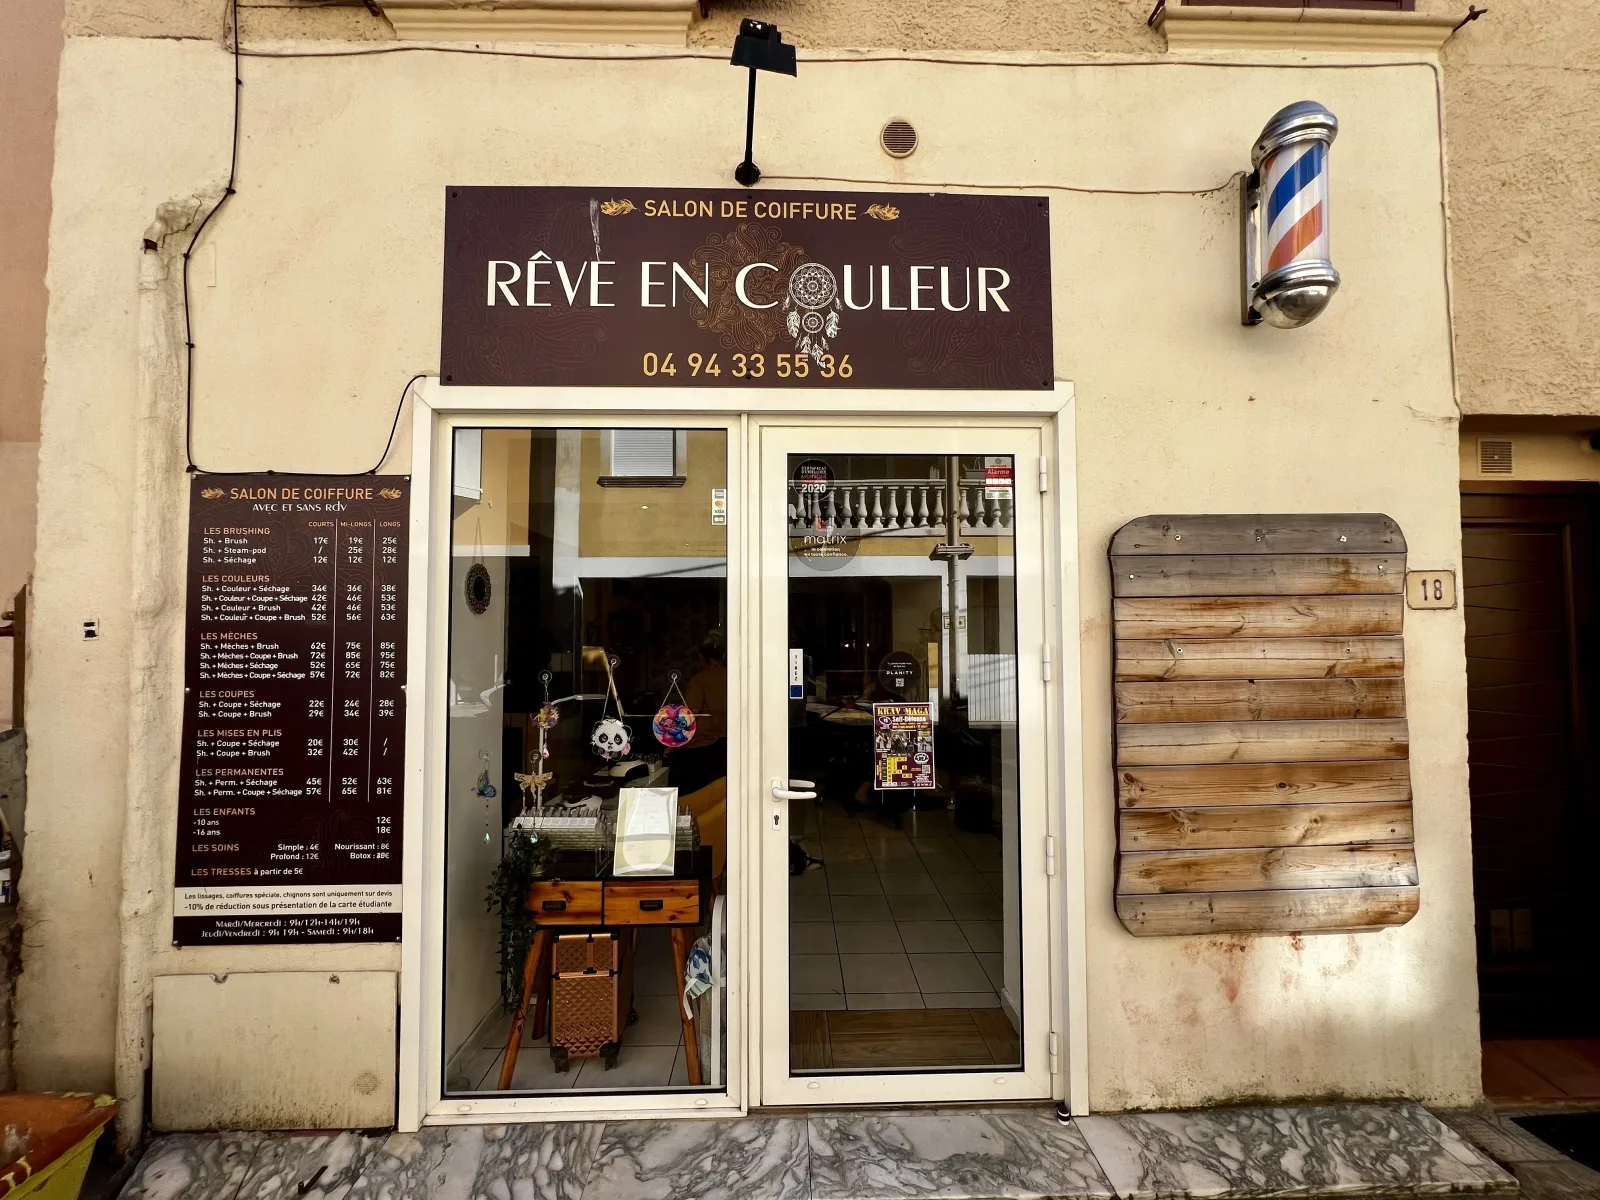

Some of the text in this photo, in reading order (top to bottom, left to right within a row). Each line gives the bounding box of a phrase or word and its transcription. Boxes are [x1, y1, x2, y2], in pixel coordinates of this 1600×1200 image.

[644, 199, 857, 221] SALON DE COIFFURE
[487, 250, 616, 307] RÊVE
[641, 261, 709, 308] EN
[643, 352, 853, 378] 04 94 33 55 36
[231, 488, 373, 499] SALON DE COIFFURE
[802, 484, 826, 492] 2020
[804, 533, 847, 544] matrix
[1422, 579, 1442, 600] 18
[221, 631, 257, 640] MÈCHES
[246, 779, 277, 787] Séchage
[272, 902, 317, 910] présentation
